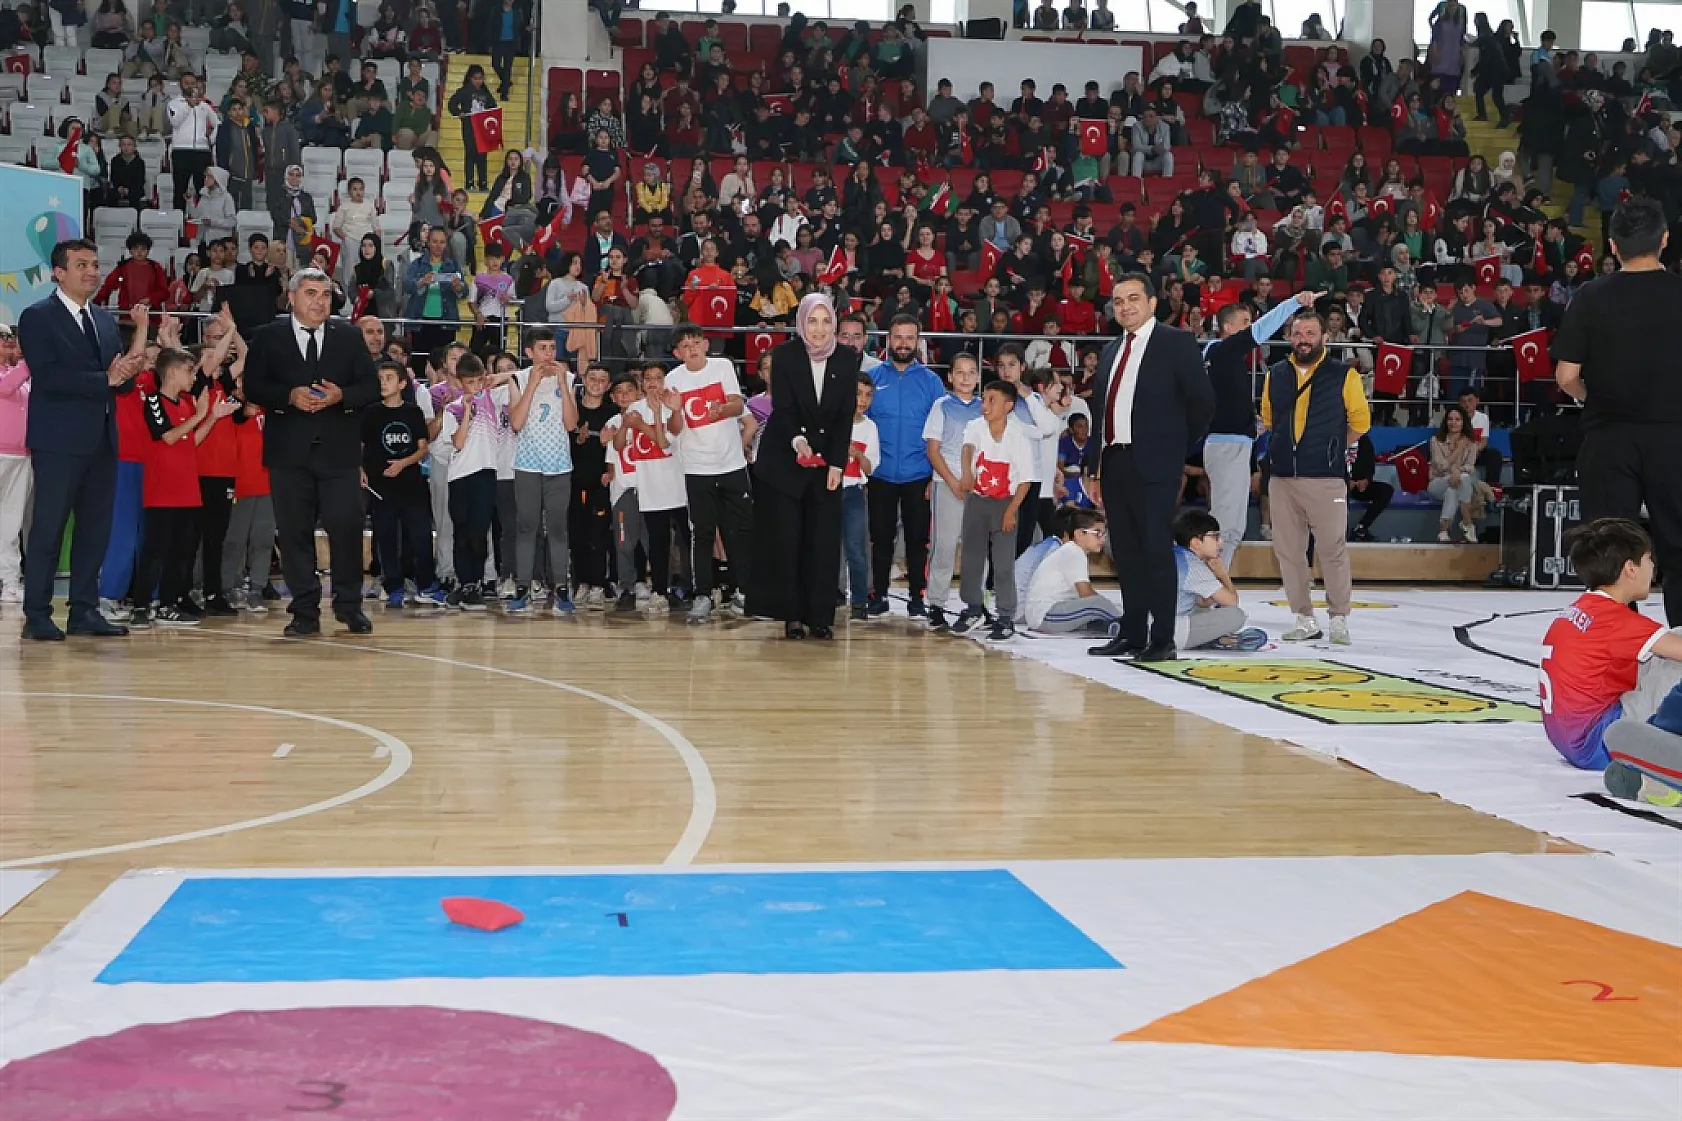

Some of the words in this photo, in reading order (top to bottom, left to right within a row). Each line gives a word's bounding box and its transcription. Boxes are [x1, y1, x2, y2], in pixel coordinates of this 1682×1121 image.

[539, 403, 551, 422] 7
[1559, 980, 1639, 1001] 2
[283, 1080, 347, 1112] 3
